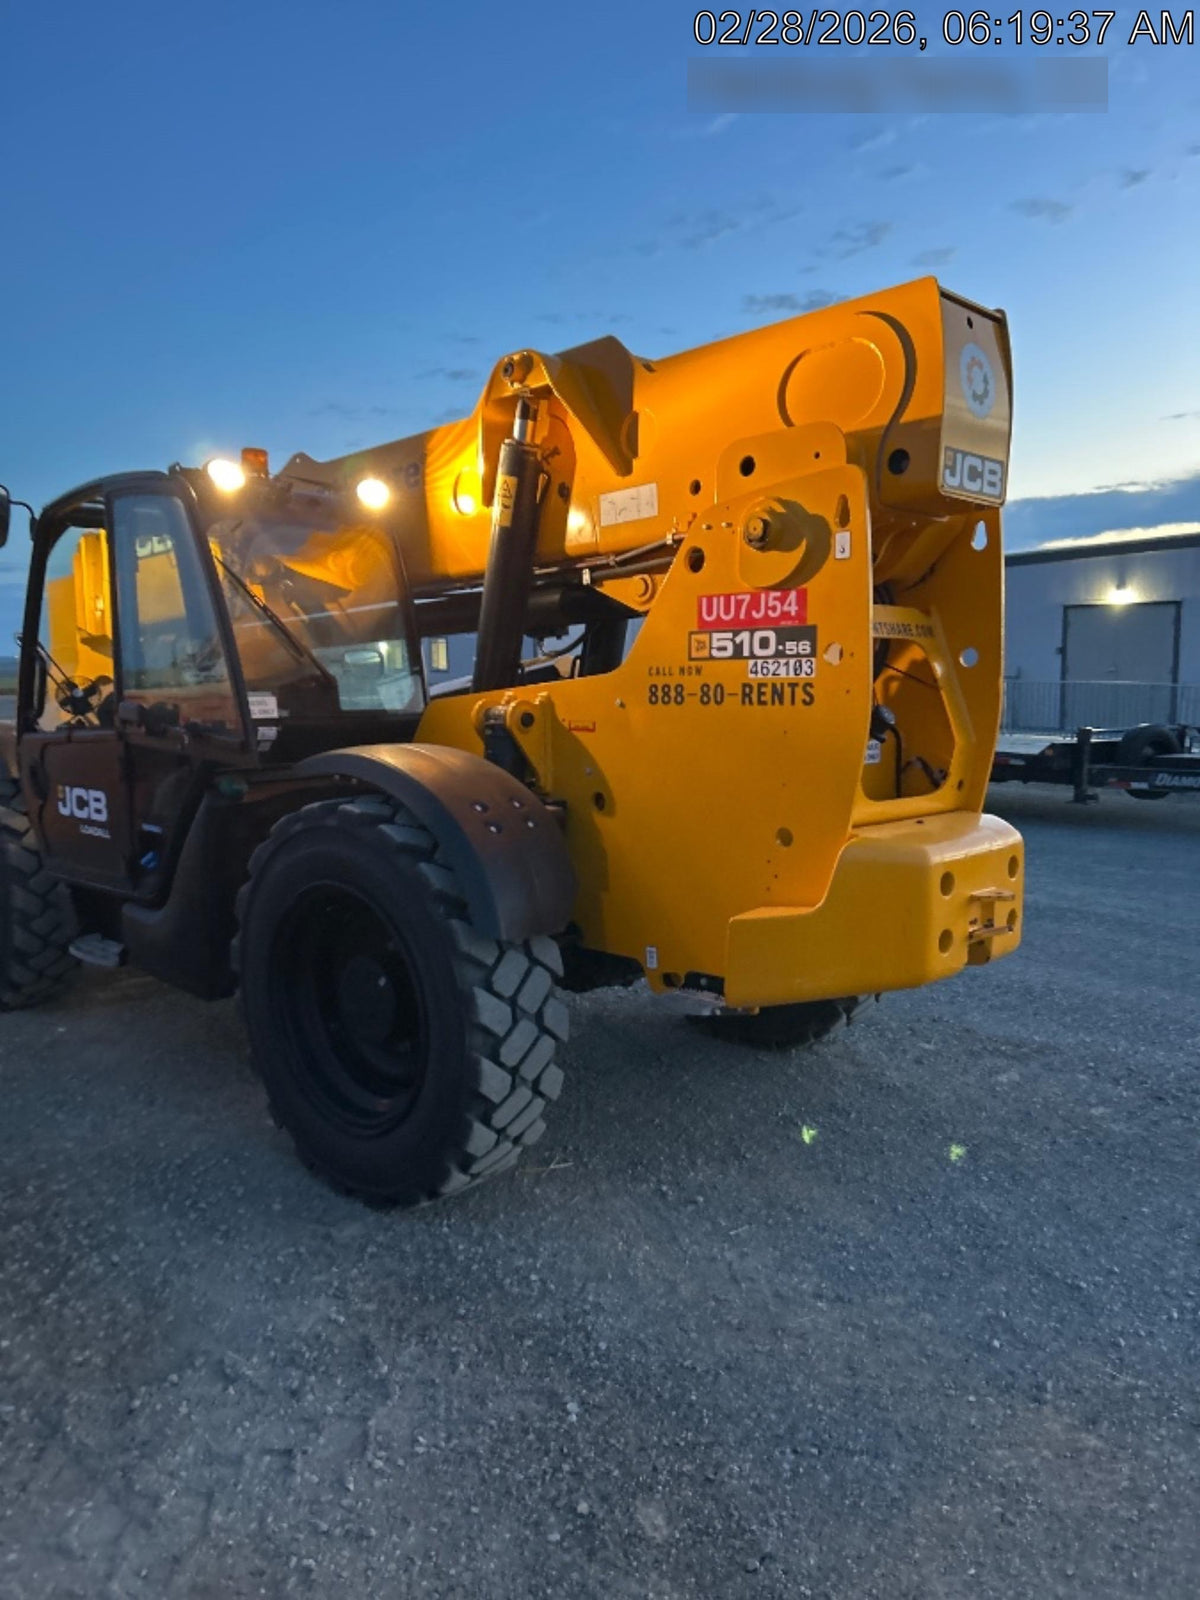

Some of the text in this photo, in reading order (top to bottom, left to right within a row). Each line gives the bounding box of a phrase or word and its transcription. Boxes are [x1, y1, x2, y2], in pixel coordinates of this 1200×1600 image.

[944, 452, 1003, 495] JCB
[701, 590, 798, 622] UU7J54
[648, 665, 703, 676] CALL NOW
[749, 659, 814, 676] 462103
[648, 682, 816, 706] 888-80-RENTS
[58, 785, 108, 822] JCB
